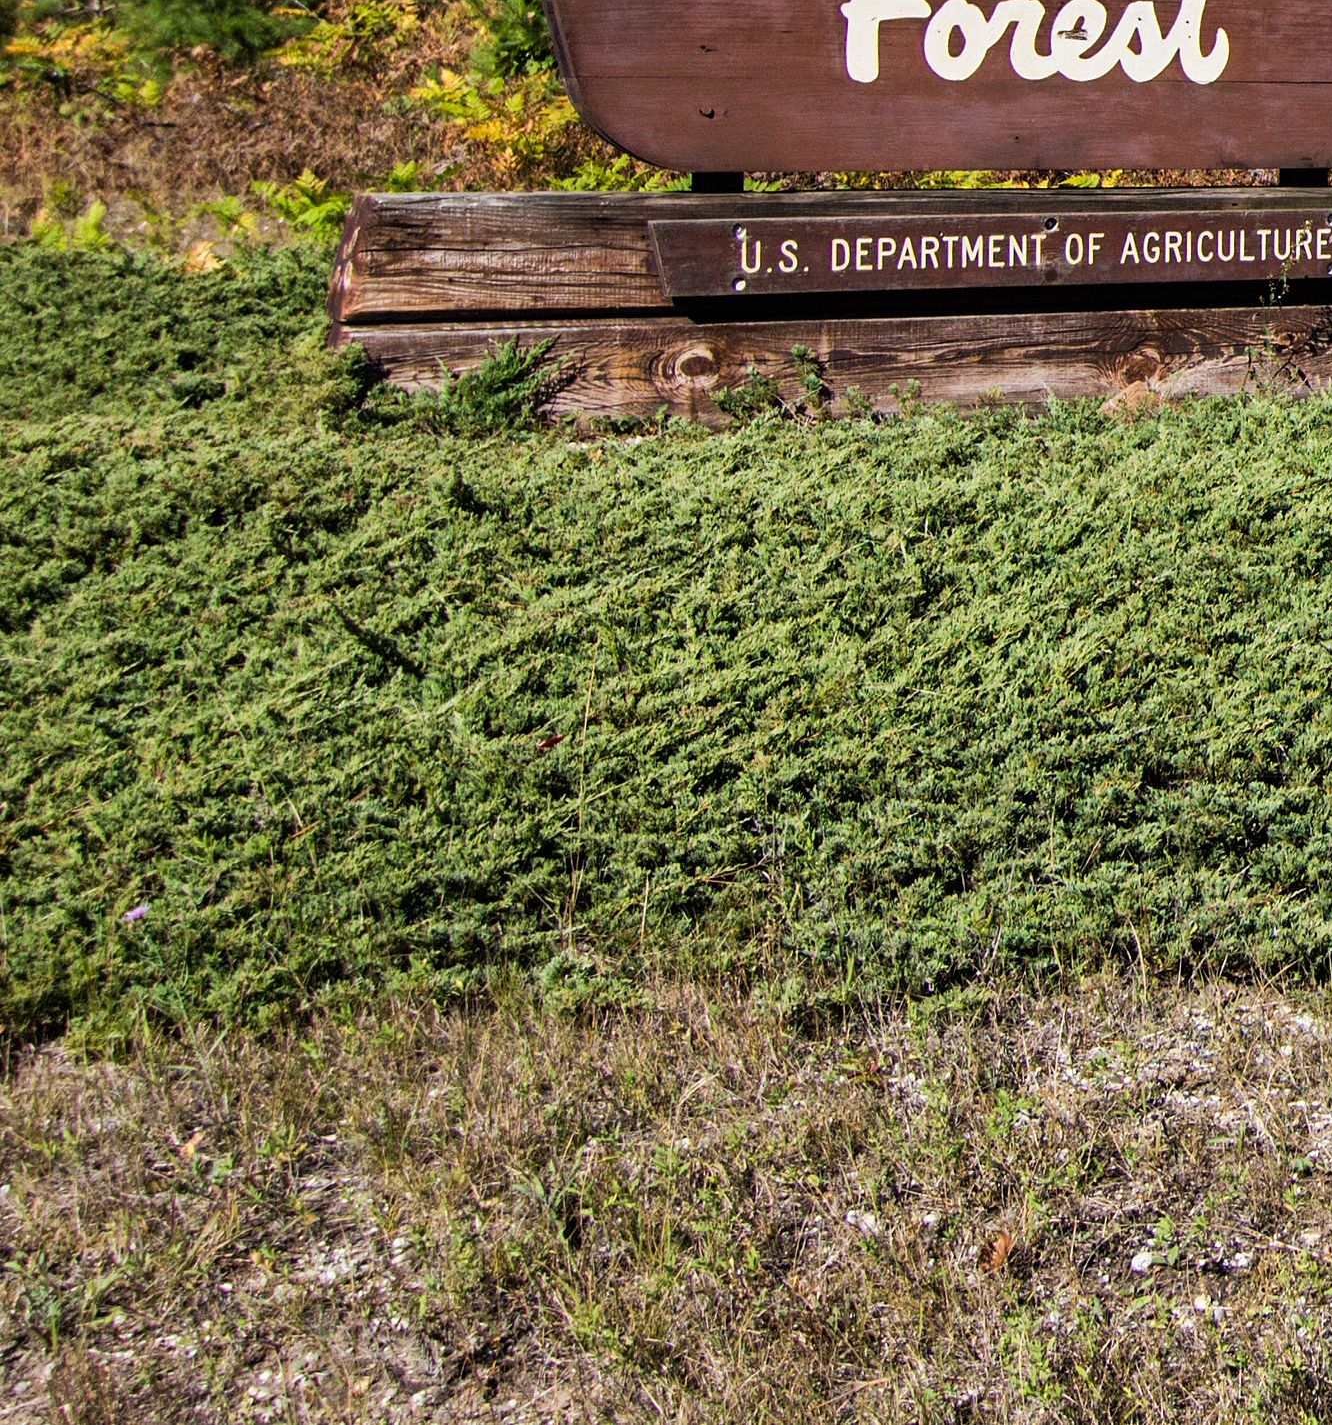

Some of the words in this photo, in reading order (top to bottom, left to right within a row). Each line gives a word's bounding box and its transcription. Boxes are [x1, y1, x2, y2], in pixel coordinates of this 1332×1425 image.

[740, 240, 810, 273] U.S.
[831, 233, 1046, 271] DEPARTMENT
[1065, 232, 1104, 263] OF
[1120, 227, 1332, 263] AGRICULTURE
